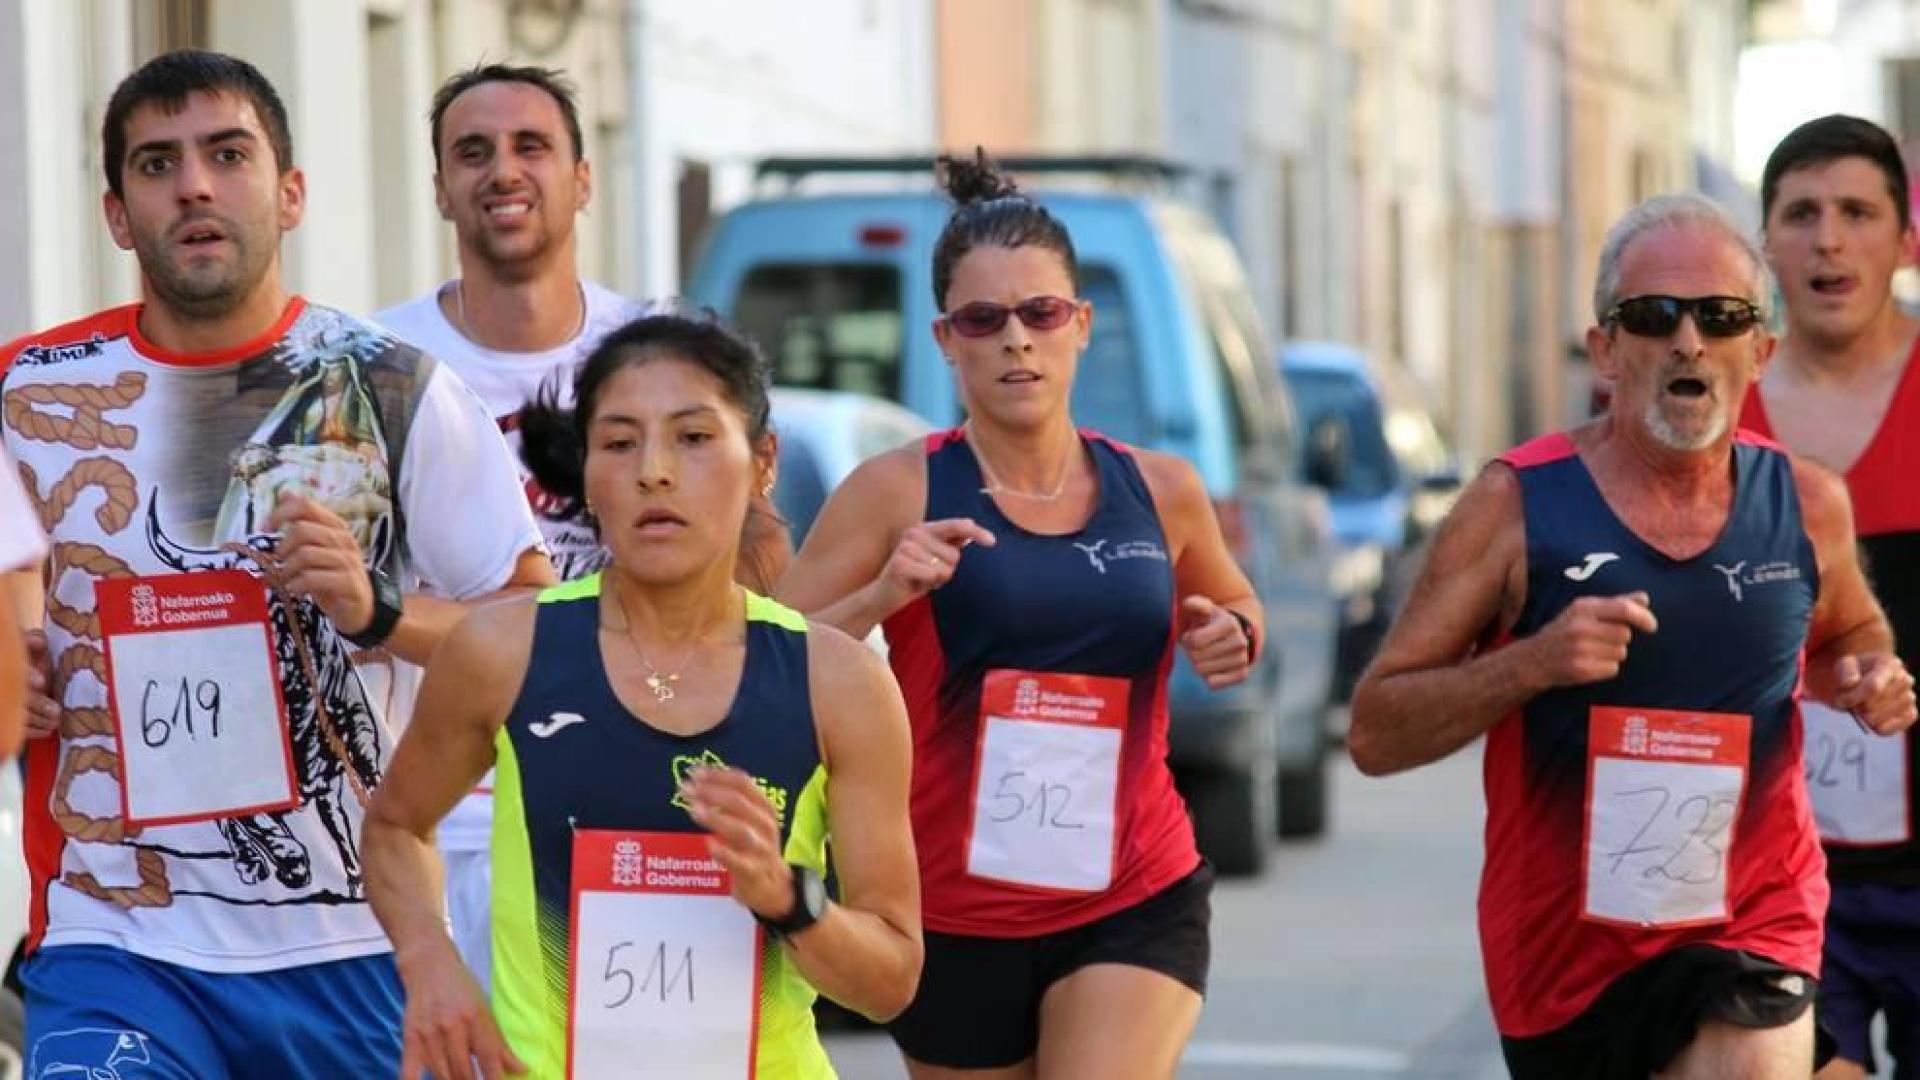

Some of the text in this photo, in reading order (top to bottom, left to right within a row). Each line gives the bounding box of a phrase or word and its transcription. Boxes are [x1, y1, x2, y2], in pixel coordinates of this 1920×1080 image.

[160, 592, 234, 608] Nafarroako
[162, 609, 228, 623] Gobernua
[141, 675, 221, 748] 619
[1804, 734, 1867, 791] 29
[989, 772, 1086, 829] 512
[1608, 787, 1736, 884] 723
[645, 871, 722, 888] Gobernua
[604, 941, 696, 1009] 511
